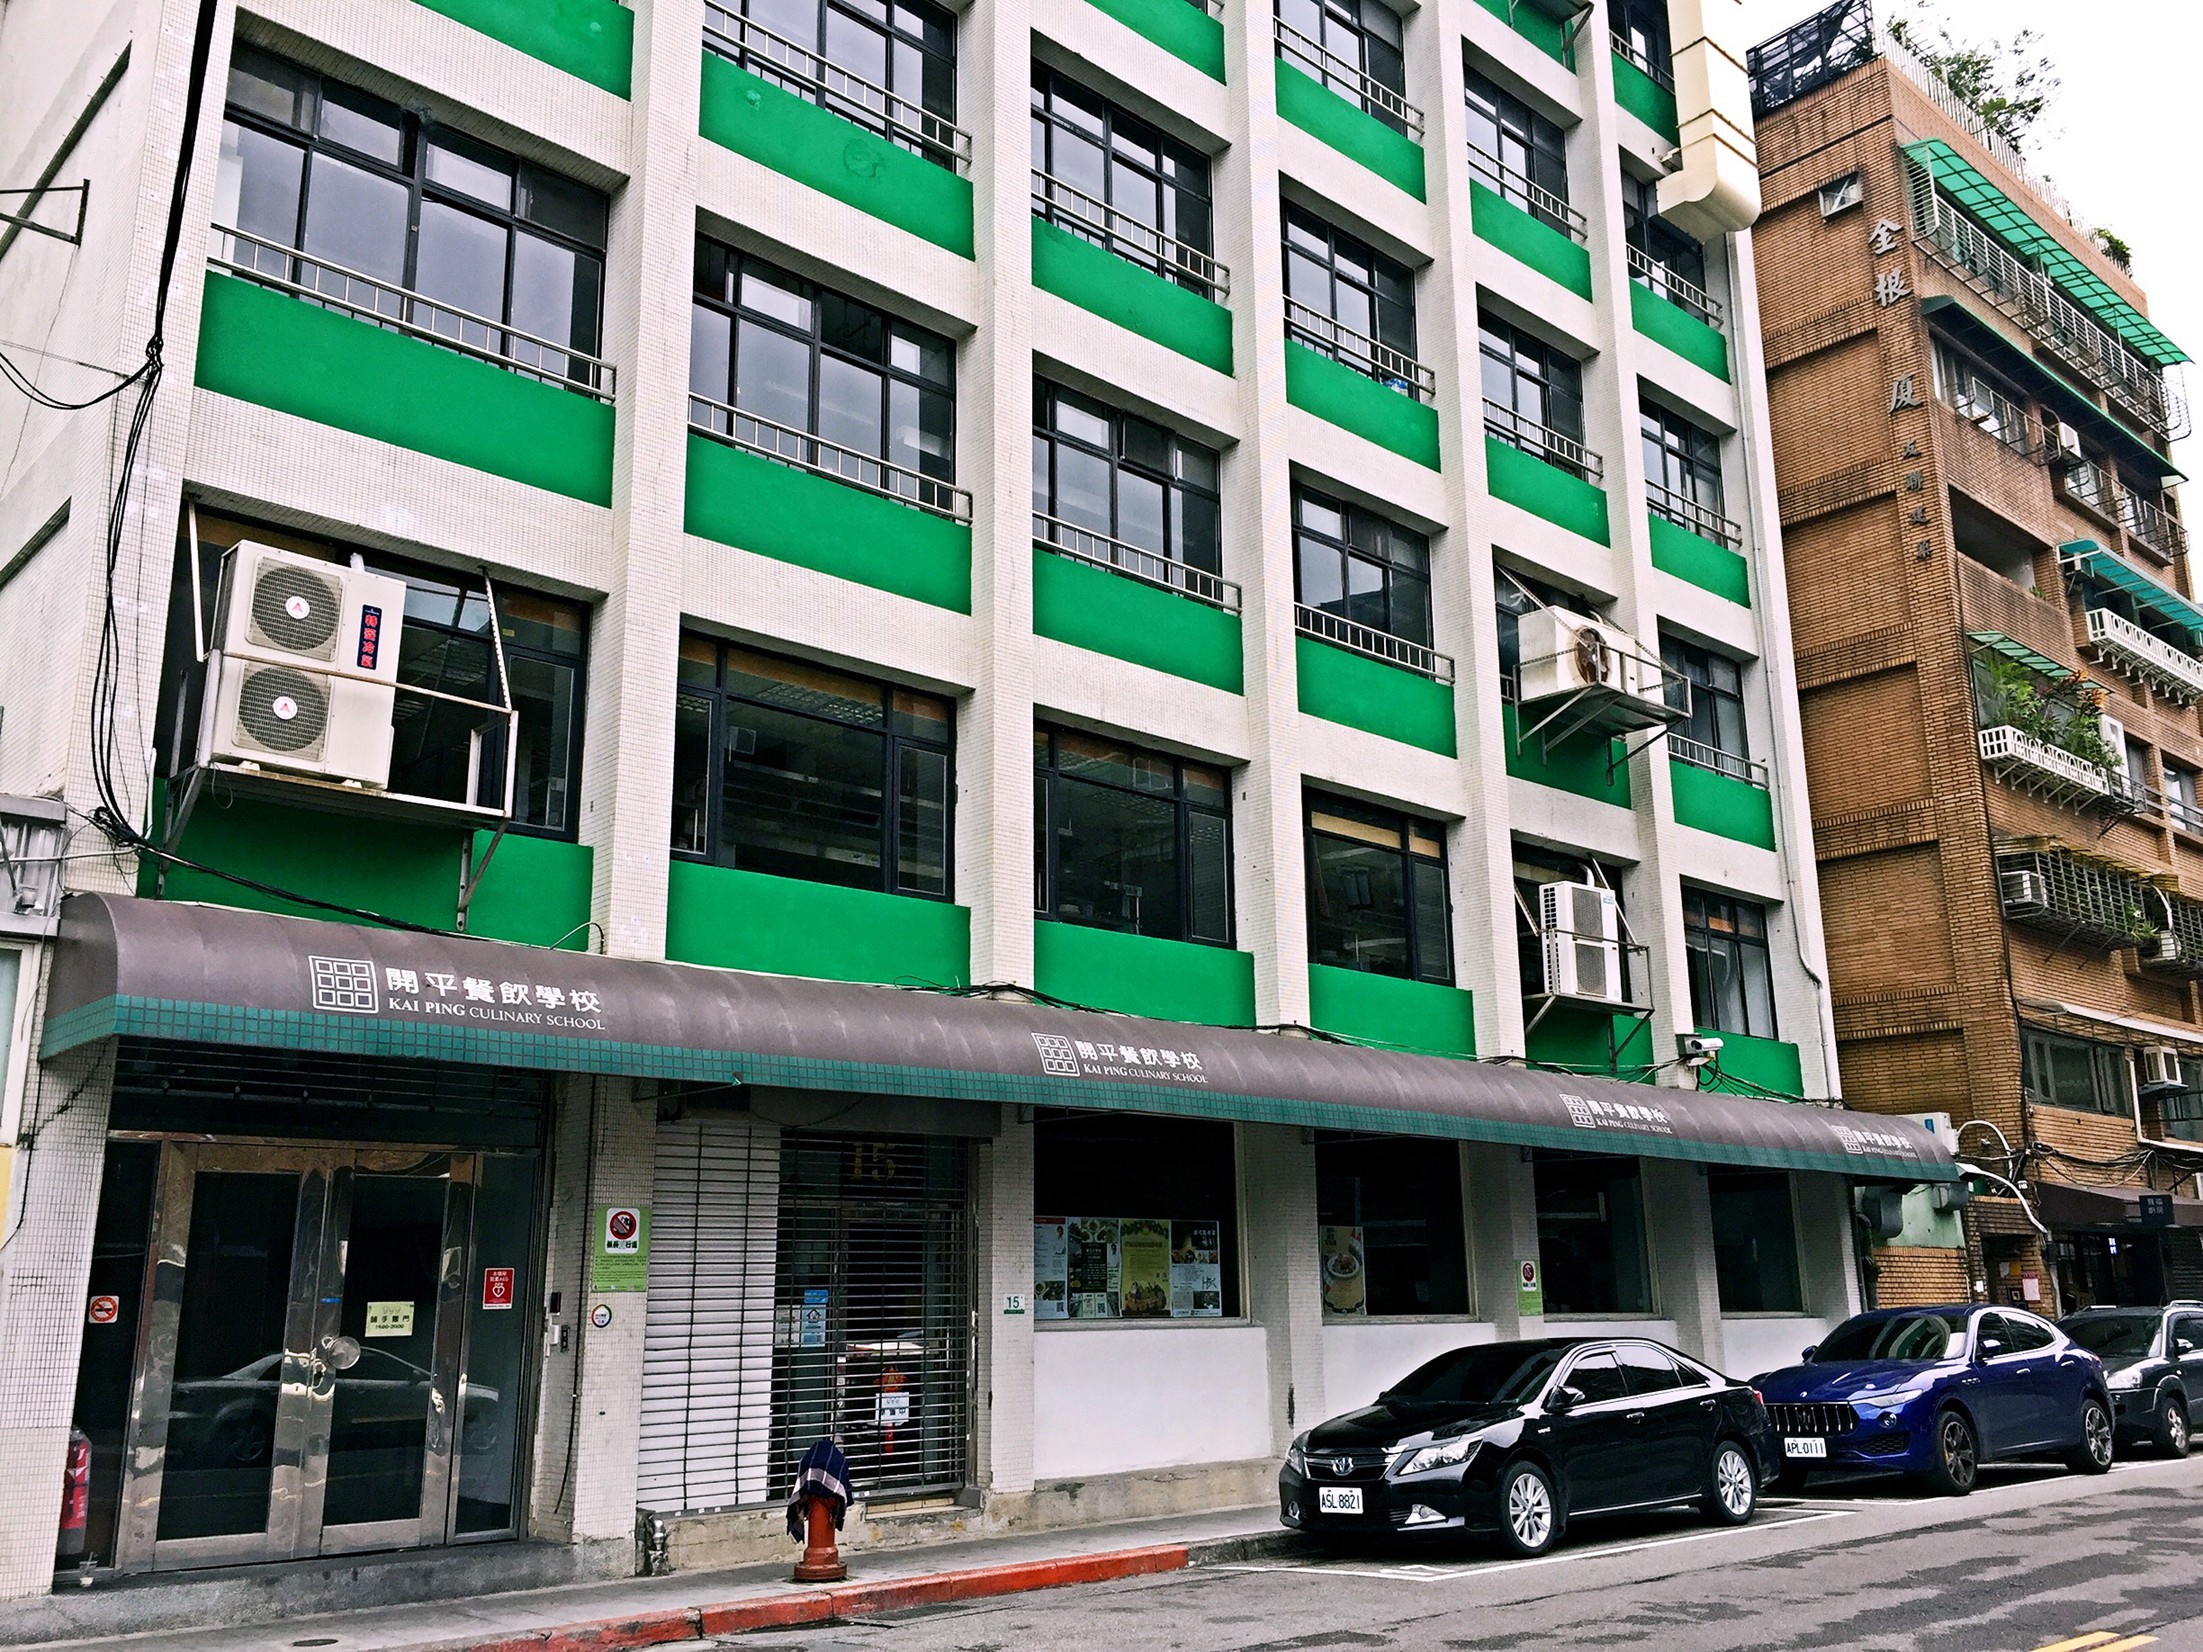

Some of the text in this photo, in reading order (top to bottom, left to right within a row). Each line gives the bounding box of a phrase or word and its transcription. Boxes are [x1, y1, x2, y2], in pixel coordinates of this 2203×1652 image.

[385, 967, 602, 1013] 開平餐飲學校
[389, 998, 605, 1030] KAI PING CULINARY SCHOOL
[1074, 1040, 1203, 1070] 開平餐飲學校
[1083, 1063, 1208, 1084] KAI PING CULINARY SCHOOL
[1006, 1296, 1020, 1308] 15
[1321, 1494, 1360, 1509] ASL-8821
